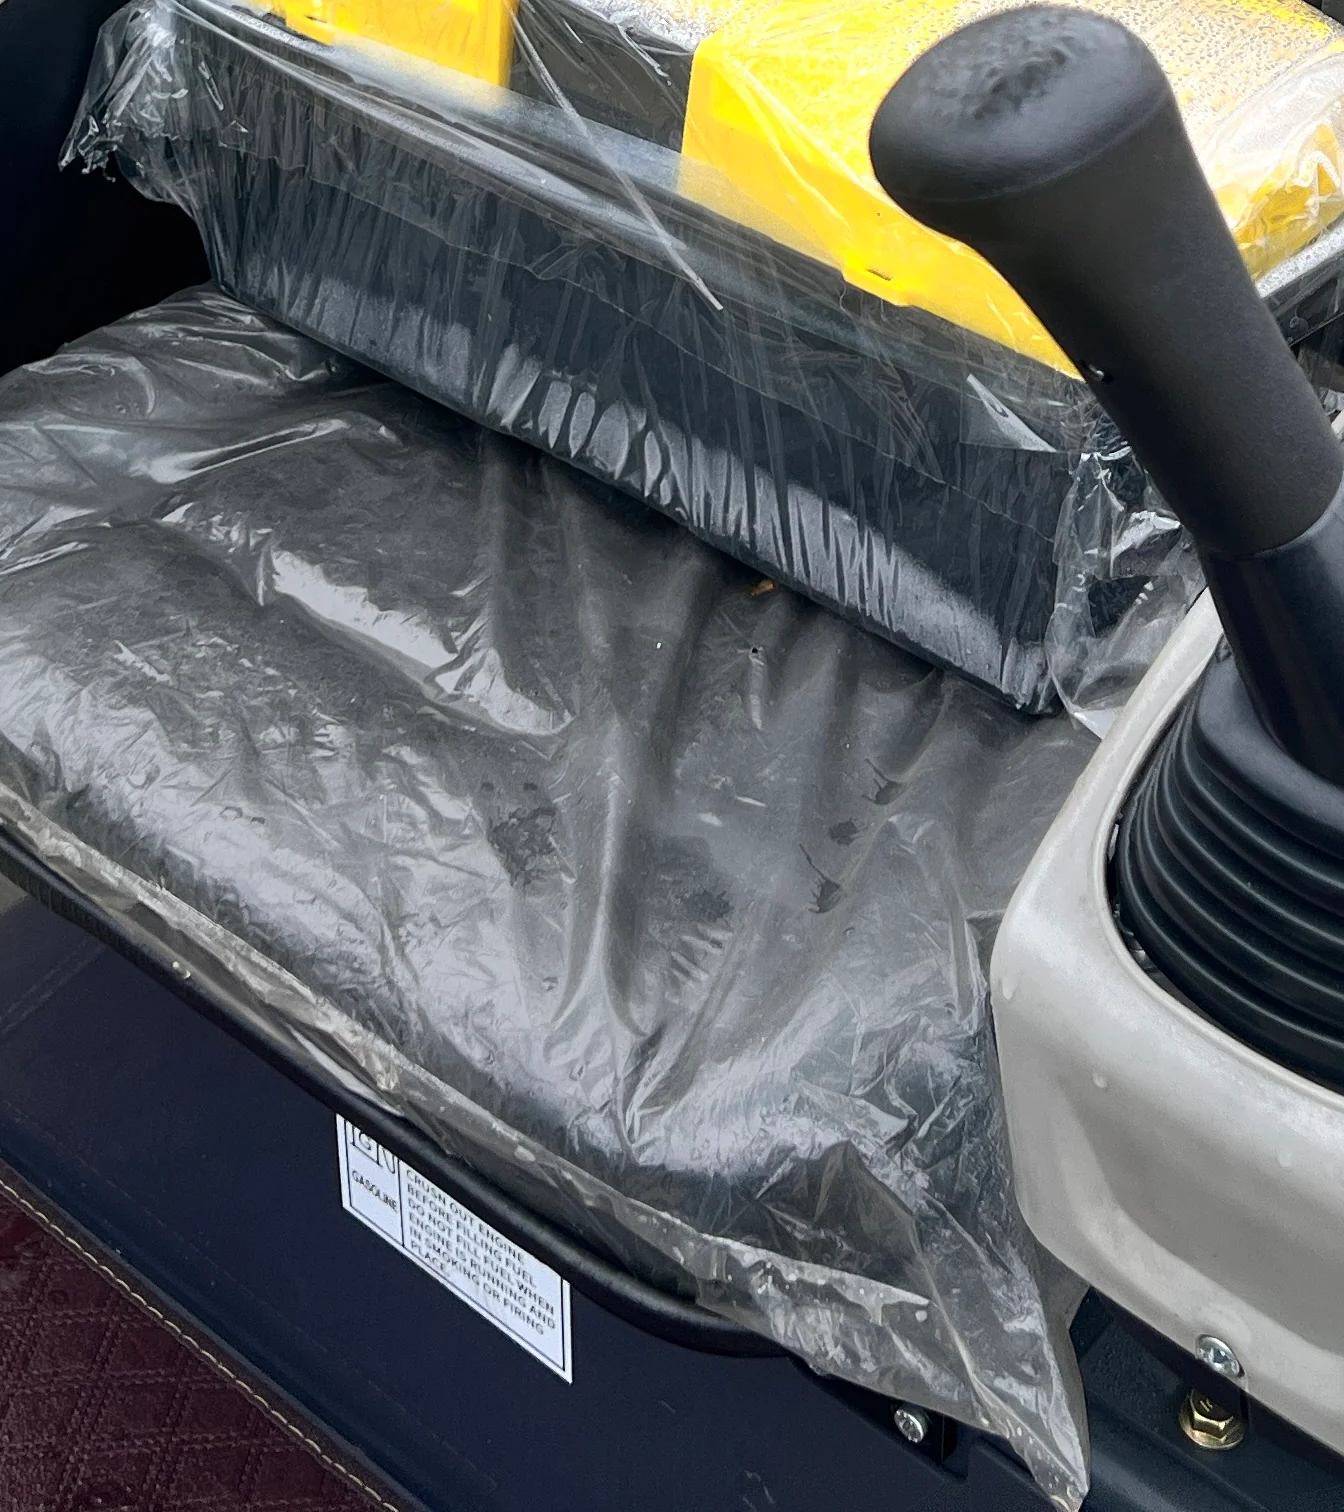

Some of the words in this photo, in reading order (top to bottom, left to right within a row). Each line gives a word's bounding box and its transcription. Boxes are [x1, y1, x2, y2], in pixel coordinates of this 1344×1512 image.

[352, 1169, 398, 1214] GASOLINE
[407, 1183, 453, 1223] BEFORE
[456, 1220, 502, 1262] FILLING
[505, 1257, 536, 1288] FUEL
[449, 1202, 475, 1226] OUT
[479, 1222, 524, 1263] ENGINE
[408, 1197, 425, 1216] DO
[428, 1211, 453, 1238] NOT
[456, 1234, 482, 1259] FILL
[483, 1252, 515, 1285] FUEL
[517, 1280, 554, 1315] WHEN
[409, 1211, 453, 1251] ENGINE
[456, 1246, 467, 1263] IS
[470, 1257, 527, 1308] RUNNING
[529, 1305, 556, 1330] AND
[410, 1225, 422, 1241] IN
[425, 1237, 480, 1286] SMOKING
[483, 1282, 500, 1303] OR
[503, 1297, 544, 1335] FIRING
